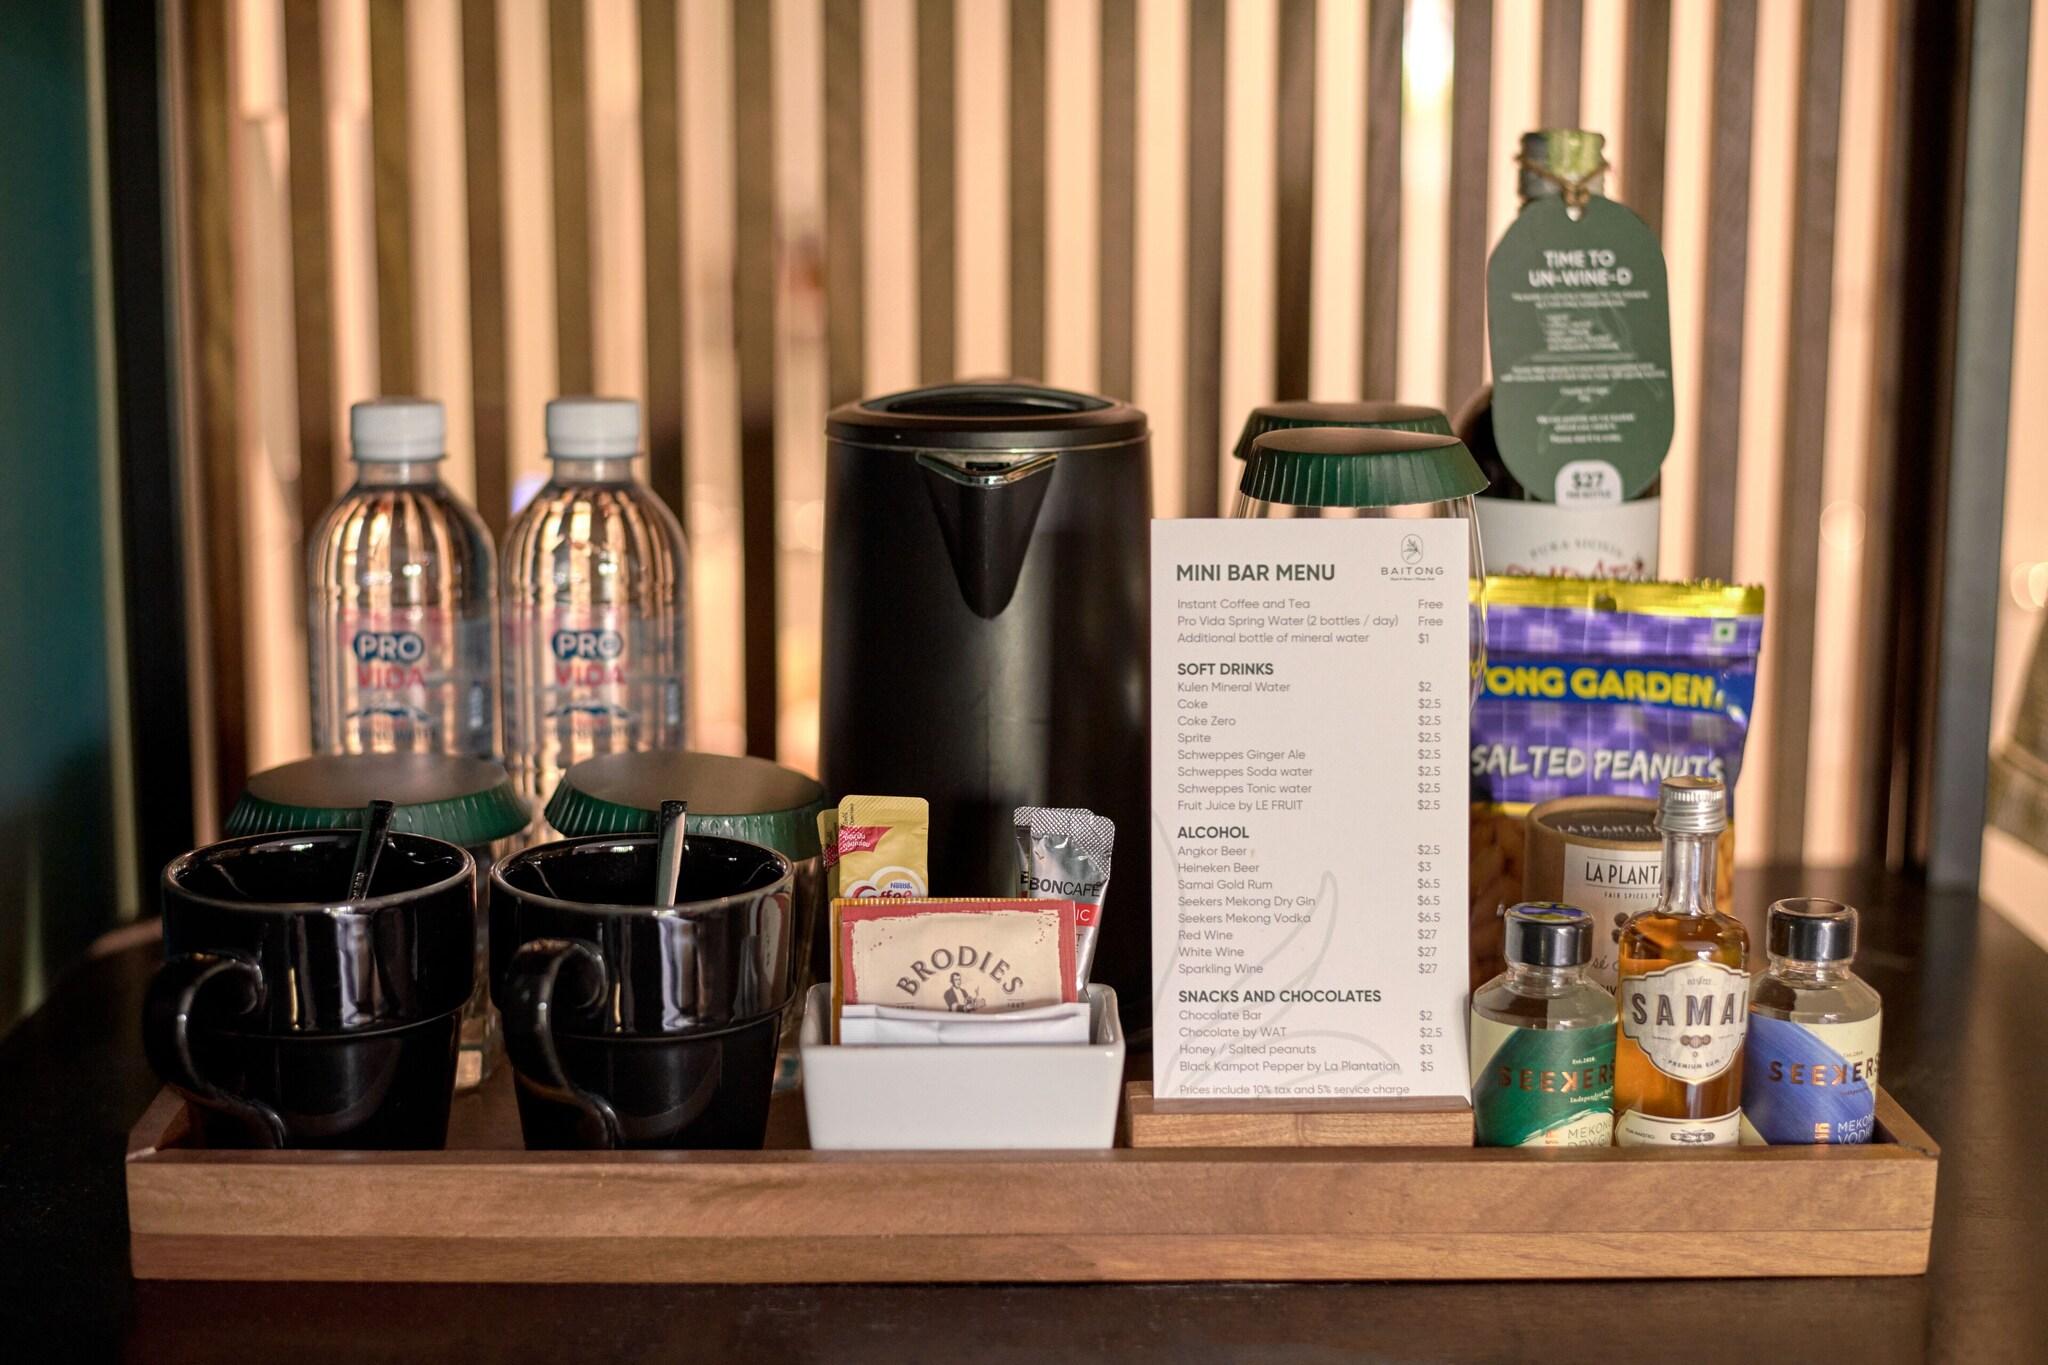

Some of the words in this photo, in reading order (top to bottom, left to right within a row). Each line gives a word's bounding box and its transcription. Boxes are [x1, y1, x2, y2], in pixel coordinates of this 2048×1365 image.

[1543, 250, 1585, 268] TIME
[1591, 249, 1615, 267] TO
[1528, 268, 1632, 287] UN-WINE-D
[1572, 472, 1603, 489] $27
[1177, 564, 1220, 581] MINI
[1228, 564, 1269, 581] BAR
[1276, 564, 1334, 581] MENU
[1381, 566, 1444, 576] BAITONG
[1178, 600, 1217, 609] Instant
[1220, 599, 1260, 608] Coffee
[1262, 599, 1285, 608] and
[1288, 598, 1310, 608] Tea
[1418, 599, 1443, 609] Free
[1178, 616, 1196, 626] Pro
[1199, 616, 1225, 626] Vida
[1228, 616, 1264, 628] Spring
[1268, 616, 1304, 626] Water
[1307, 615, 1317, 626] (2
[1320, 616, 1360, 626] bottles
[1373, 615, 1398, 628] day)
[1418, 616, 1443, 626] Free
[1177, 632, 1236, 643] Additional
[1239, 633, 1274, 643] bottle
[1276, 632, 1288, 643] of
[1291, 632, 1333, 643] mineral
[1336, 634, 1369, 643] water
[1418, 633, 1429, 644] $1
[358, 634, 423, 660] PRO
[558, 633, 623, 659] PRO
[555, 664, 626, 686] VIDA
[1178, 663, 1216, 675] SOFT
[1220, 663, 1273, 675] DRINKS
[358, 667, 425, 689] VIDA
[1178, 682, 1208, 692] Kulen
[1211, 682, 1252, 692] Mineral
[1255, 682, 1290, 692] Water
[1418, 681, 1432, 692] $2
[1570, 668, 1716, 708] GARDEN
[1177, 699, 1208, 709] Coke
[1418, 698, 1441, 709] $2.5
[1177, 716, 1208, 726] Coke
[1211, 716, 1236, 726] Zero
[1418, 715, 1441, 726] $2.5
[1178, 733, 1211, 744] Sprite
[1418, 732, 1441, 743] $2.5
[1178, 749, 1244, 762] Schweppes
[1246, 749, 1285, 762] Ginger
[1288, 749, 1305, 759] Ale
[1418, 749, 1441, 760] $2.5
[1471, 744, 1586, 779] SALTED
[1594, 751, 1724, 785] PEANUTS
[1178, 766, 1244, 779] Schweppes
[1247, 766, 1277, 776] Soda
[1280, 768, 1312, 776] water
[1418, 765, 1440, 776] $2.5
[1178, 784, 1244, 796] Schweppes
[1246, 783, 1276, 793] Tonic
[1279, 785, 1312, 793] water
[1418, 782, 1440, 794] $2.5
[1178, 800, 1202, 810] Fruit
[1205, 800, 1235, 810] Juice
[1238, 800, 1253, 812] by
[1256, 800, 1268, 810] LE
[1272, 800, 1303, 810] FRUIT
[1418, 799, 1440, 810] $2.5
[1178, 826, 1249, 838] ALCOHOL
[1178, 846, 1218, 858] Angkor
[1221, 846, 1247, 856] Beer
[1417, 844, 1440, 855] $2.5
[1178, 863, 1230, 872] Heineken
[1234, 862, 1259, 872] Beer
[1418, 861, 1431, 872] $3
[1585, 861, 1604, 883] LA
[1178, 880, 1214, 890] Samai
[1217, 880, 1244, 889] Gold
[1248, 880, 1272, 889] Rum
[1417, 878, 1440, 889] $6.5
[1178, 896, 1223, 907] Seekers
[1225, 896, 1271, 909] Mekong
[1274, 896, 1293, 908] Dry
[1296, 896, 1316, 906] Gin
[1417, 895, 1440, 906] $6.5
[1178, 913, 1223, 923] Seekers
[1226, 913, 1271, 925] Mekong
[1274, 913, 1312, 925] Vodka
[1418, 912, 1440, 923] $6.5
[1178, 929, 1201, 940] Red
[1204, 930, 1233, 940] Wine
[1418, 929, 1437, 940] $27
[1178, 946, 1212, 957] White
[1215, 947, 1244, 957] Wine
[1417, 946, 1437, 957] $27
[896, 945, 1024, 996] BRODIES
[1179, 963, 1231, 976] Sparkling
[1234, 964, 1263, 974] Wine
[1419, 963, 1437, 974] $27
[1179, 990, 1239, 1002] SNACKS
[1243, 990, 1275, 1002] AND
[1279, 990, 1381, 1002] CHOCOLATES
[1179, 1009, 1240, 1022] Chocolate
[1242, 1008, 1261, 1020] Bar
[1419, 1010, 1432, 1021] $2
[1179, 1027, 1239, 1040] Chocolate
[1243, 1027, 1258, 1039] by
[1260, 1027, 1286, 1037] WAT
[1419, 1027, 1442, 1038] $2.5
[1179, 1043, 1216, 1056] Honey
[1229, 1043, 1266, 1056] Salted
[1269, 1045, 1316, 1056] peanuts
[1420, 1044, 1433, 1055] $3
[1180, 1061, 1212, 1071] Black
[1214, 1061, 1259, 1073] Kampot
[1263, 1061, 1304, 1072] Pepper
[1307, 1062, 1321, 1074] by
[1324, 1061, 1338, 1071] La
[1341, 1061, 1400, 1073] Plantation
[1420, 1061, 1434, 1072] $5
[1179, 1084, 1209, 1094] Prices
[1212, 1083, 1249, 1094] include
[1253, 1084, 1271, 1094] 10%
[1275, 1084, 1291, 1094] tax
[1294, 1083, 1314, 1094] and
[1317, 1083, 1331, 1094] 5%
[1334, 1084, 1370, 1094] service
[1373, 1083, 1410, 1098] charge
